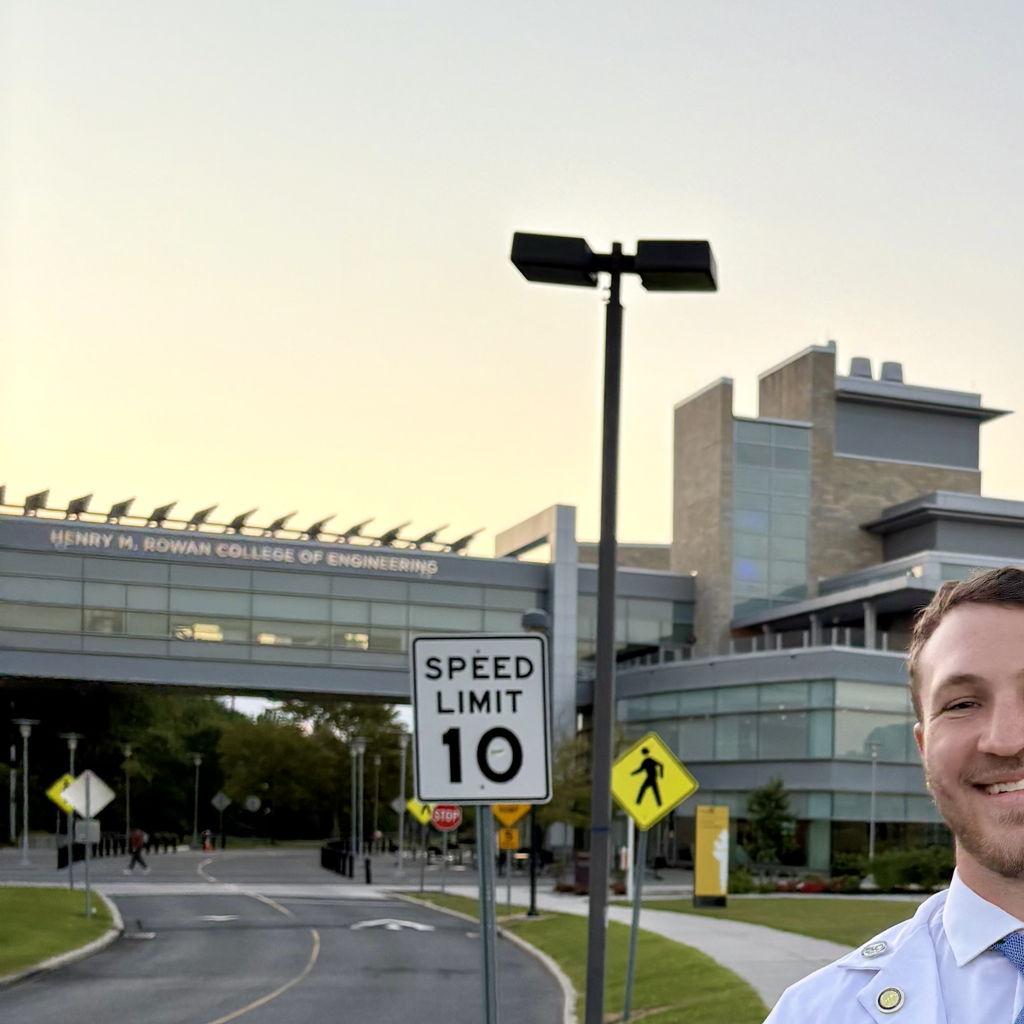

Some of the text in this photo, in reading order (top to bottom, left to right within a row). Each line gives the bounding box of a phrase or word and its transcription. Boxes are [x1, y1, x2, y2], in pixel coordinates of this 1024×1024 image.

[50, 529, 113, 548] HENRY
[143, 537, 211, 556] ROWAN
[216, 543, 294, 563] COLLEGE
[299, 549, 323, 565] OF
[327, 552, 438, 575] ENGINEERING
[425, 657, 534, 680] SPEED
[437, 690, 522, 714] LIMIT
[442, 727, 523, 783] 10
[434, 810, 459, 821] STOP
